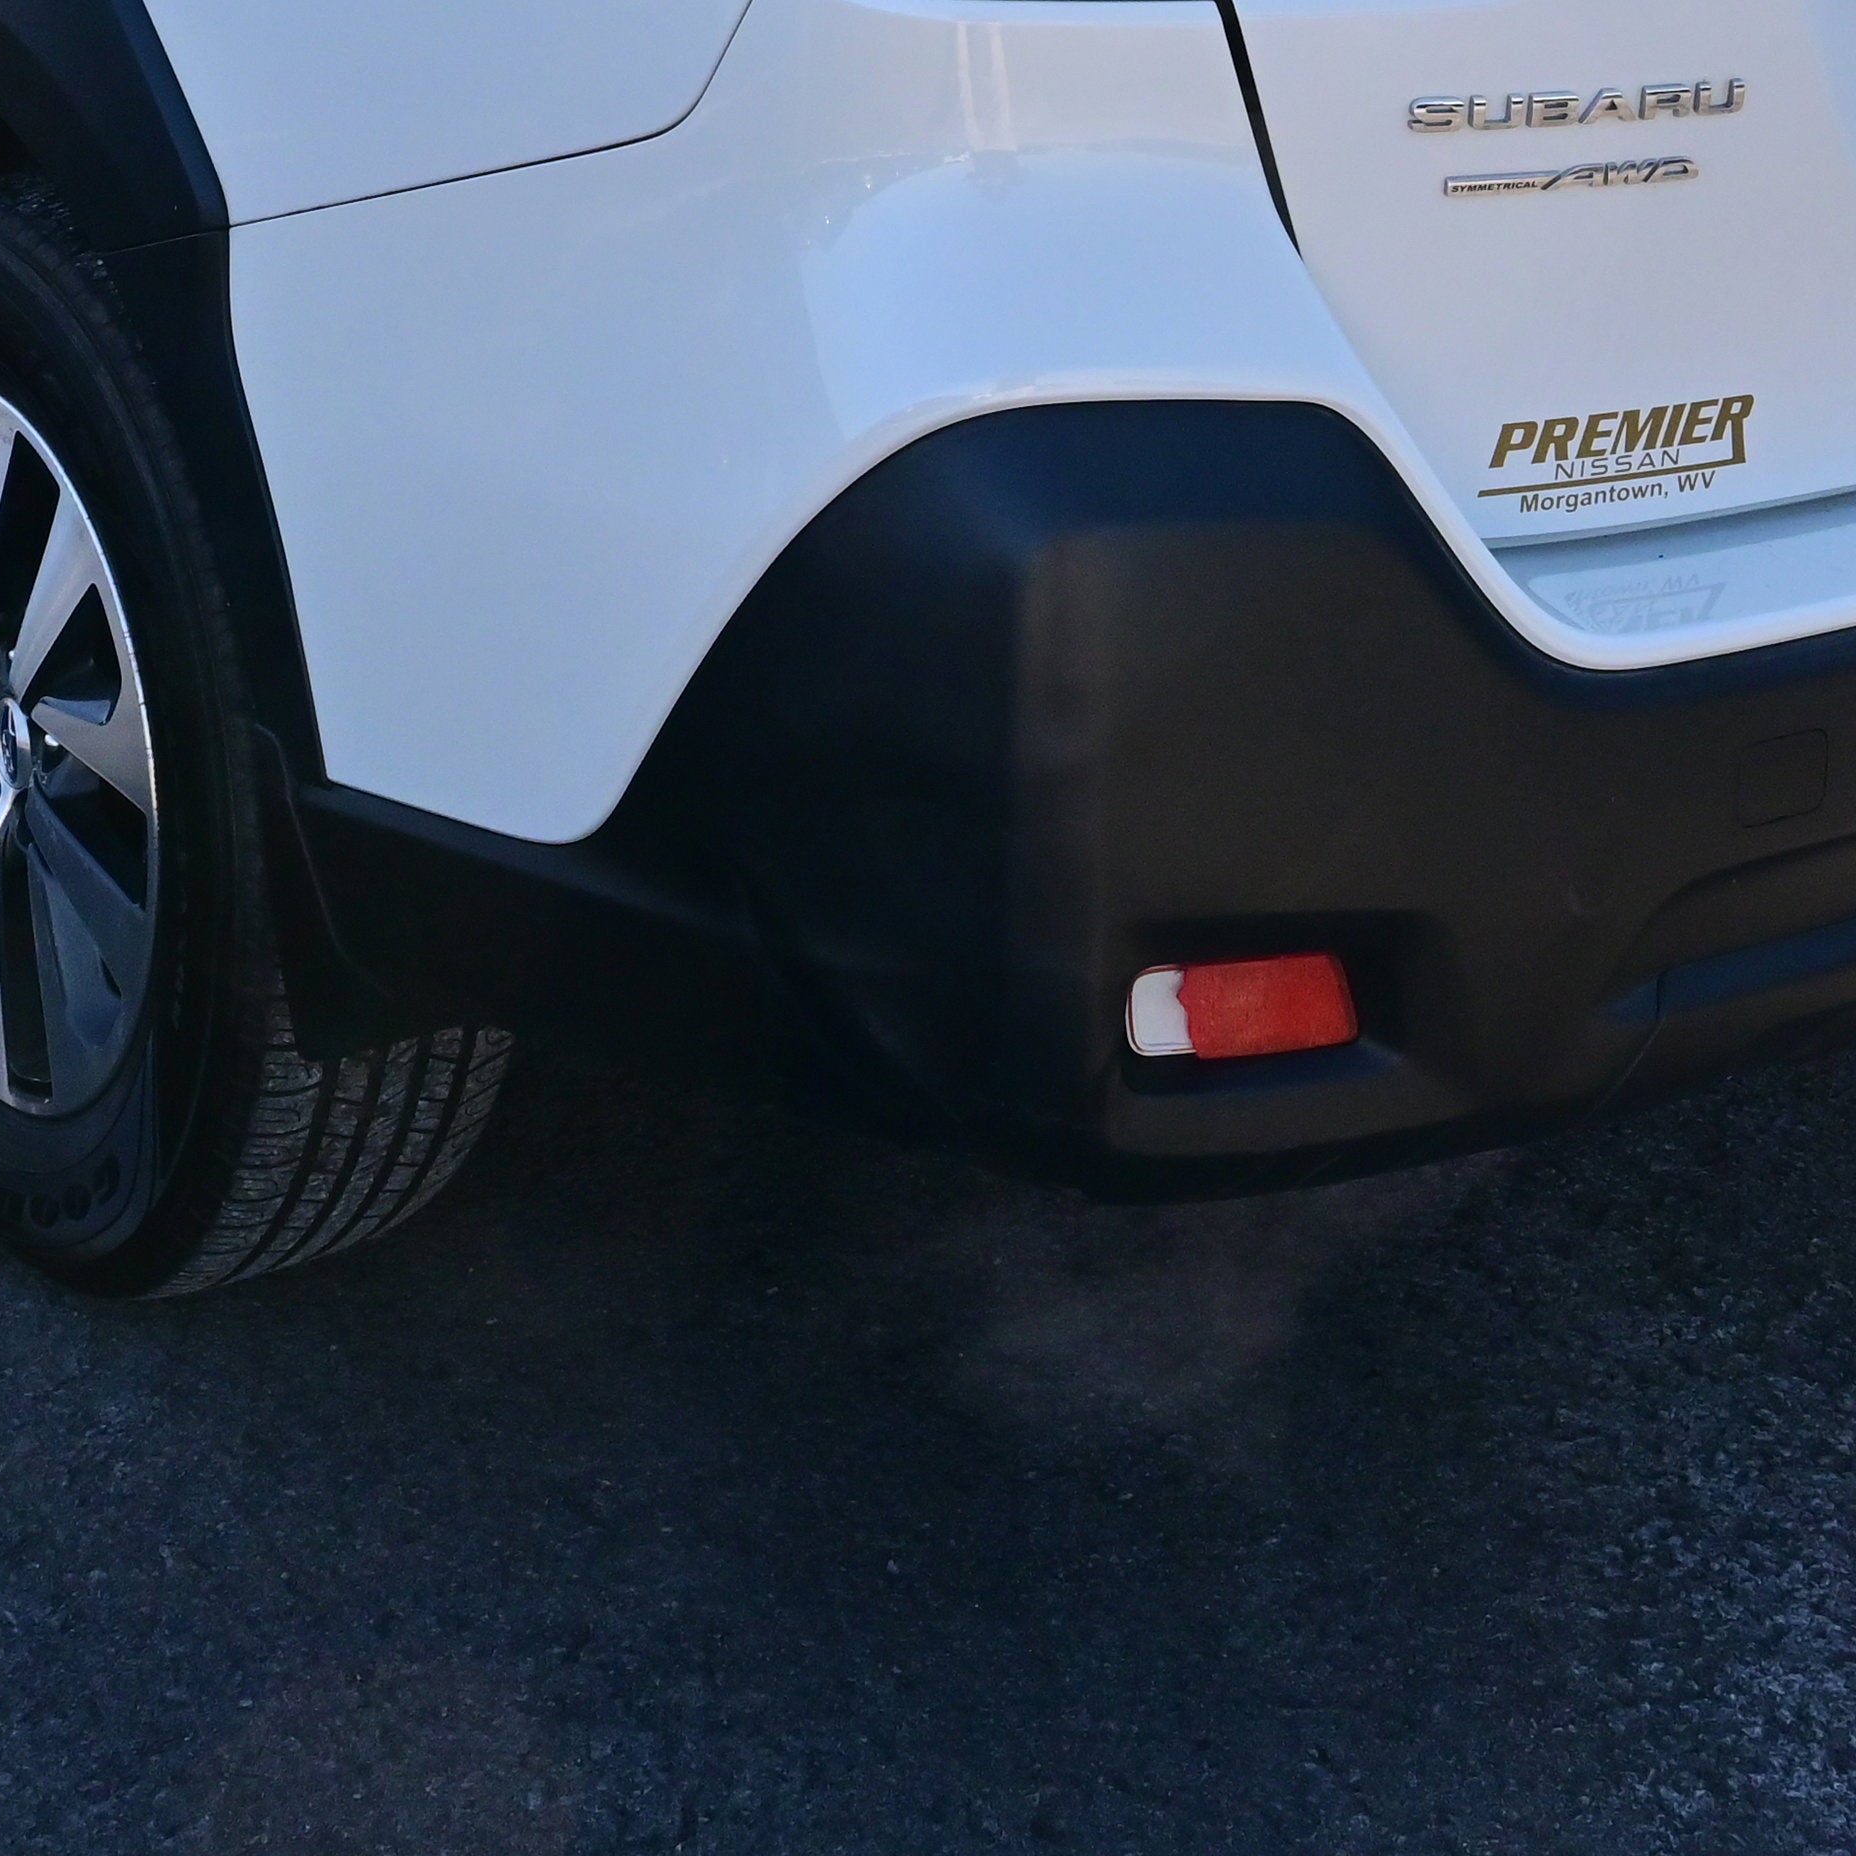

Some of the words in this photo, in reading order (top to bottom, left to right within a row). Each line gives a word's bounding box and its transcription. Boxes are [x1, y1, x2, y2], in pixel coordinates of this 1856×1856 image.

[1407, 77, 1745, 133] SUBARU
[1451, 180, 1538, 194] SYMMETRICAL
[1541, 155, 1700, 192] AWD
[1489, 394, 1754, 469] PREMIER
[1554, 448, 1680, 481] NISSAN
[1519, 481, 1669, 513] Morgantown,
[1677, 470, 1716, 493] WV
